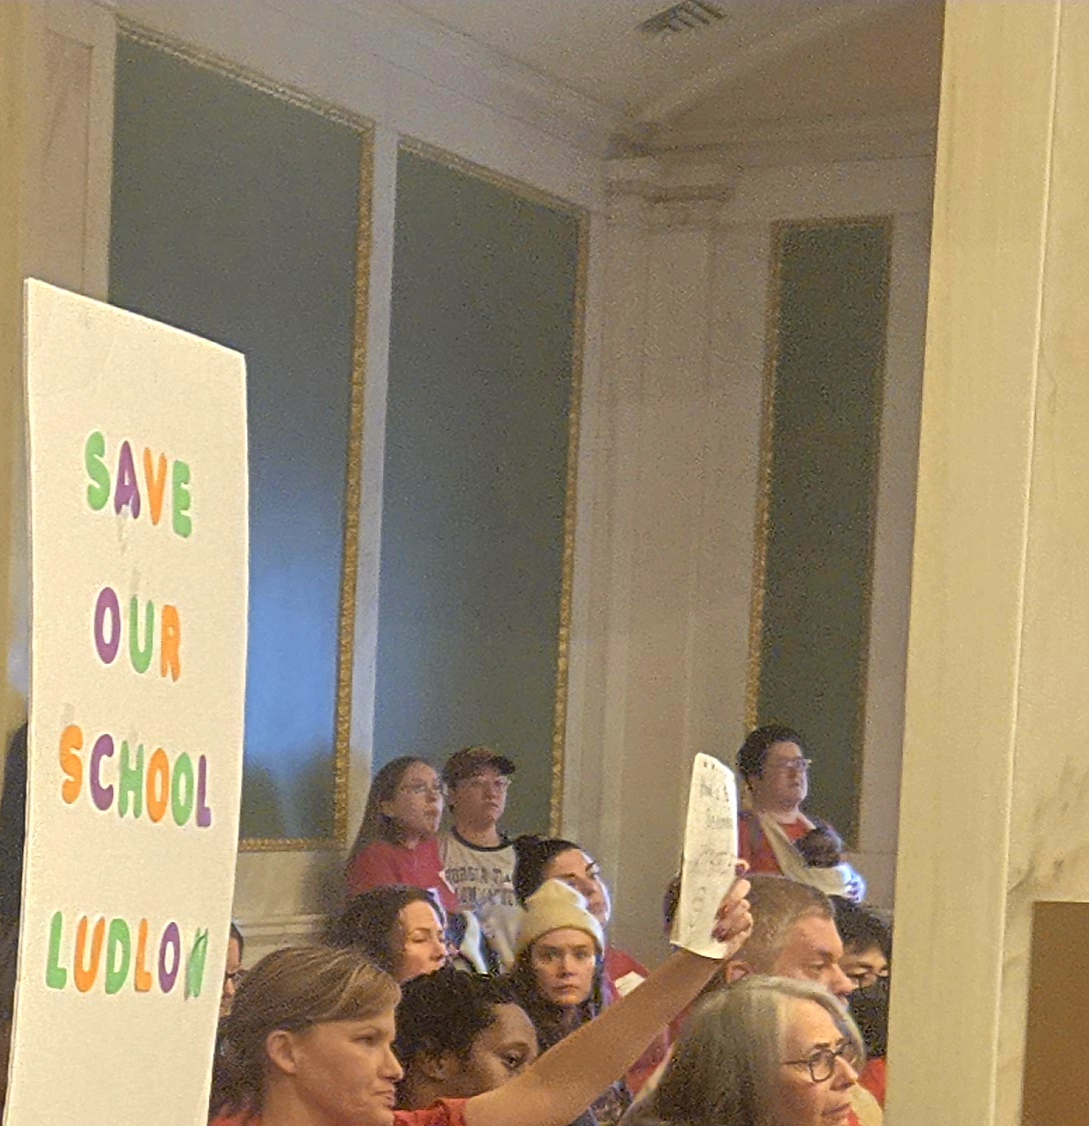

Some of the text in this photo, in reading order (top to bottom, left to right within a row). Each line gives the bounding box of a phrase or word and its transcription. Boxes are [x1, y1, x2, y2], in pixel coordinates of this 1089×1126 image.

[84, 430, 193, 540] SAVE
[94, 586, 182, 683] OUR
[60, 724, 212, 828] SCHOOL
